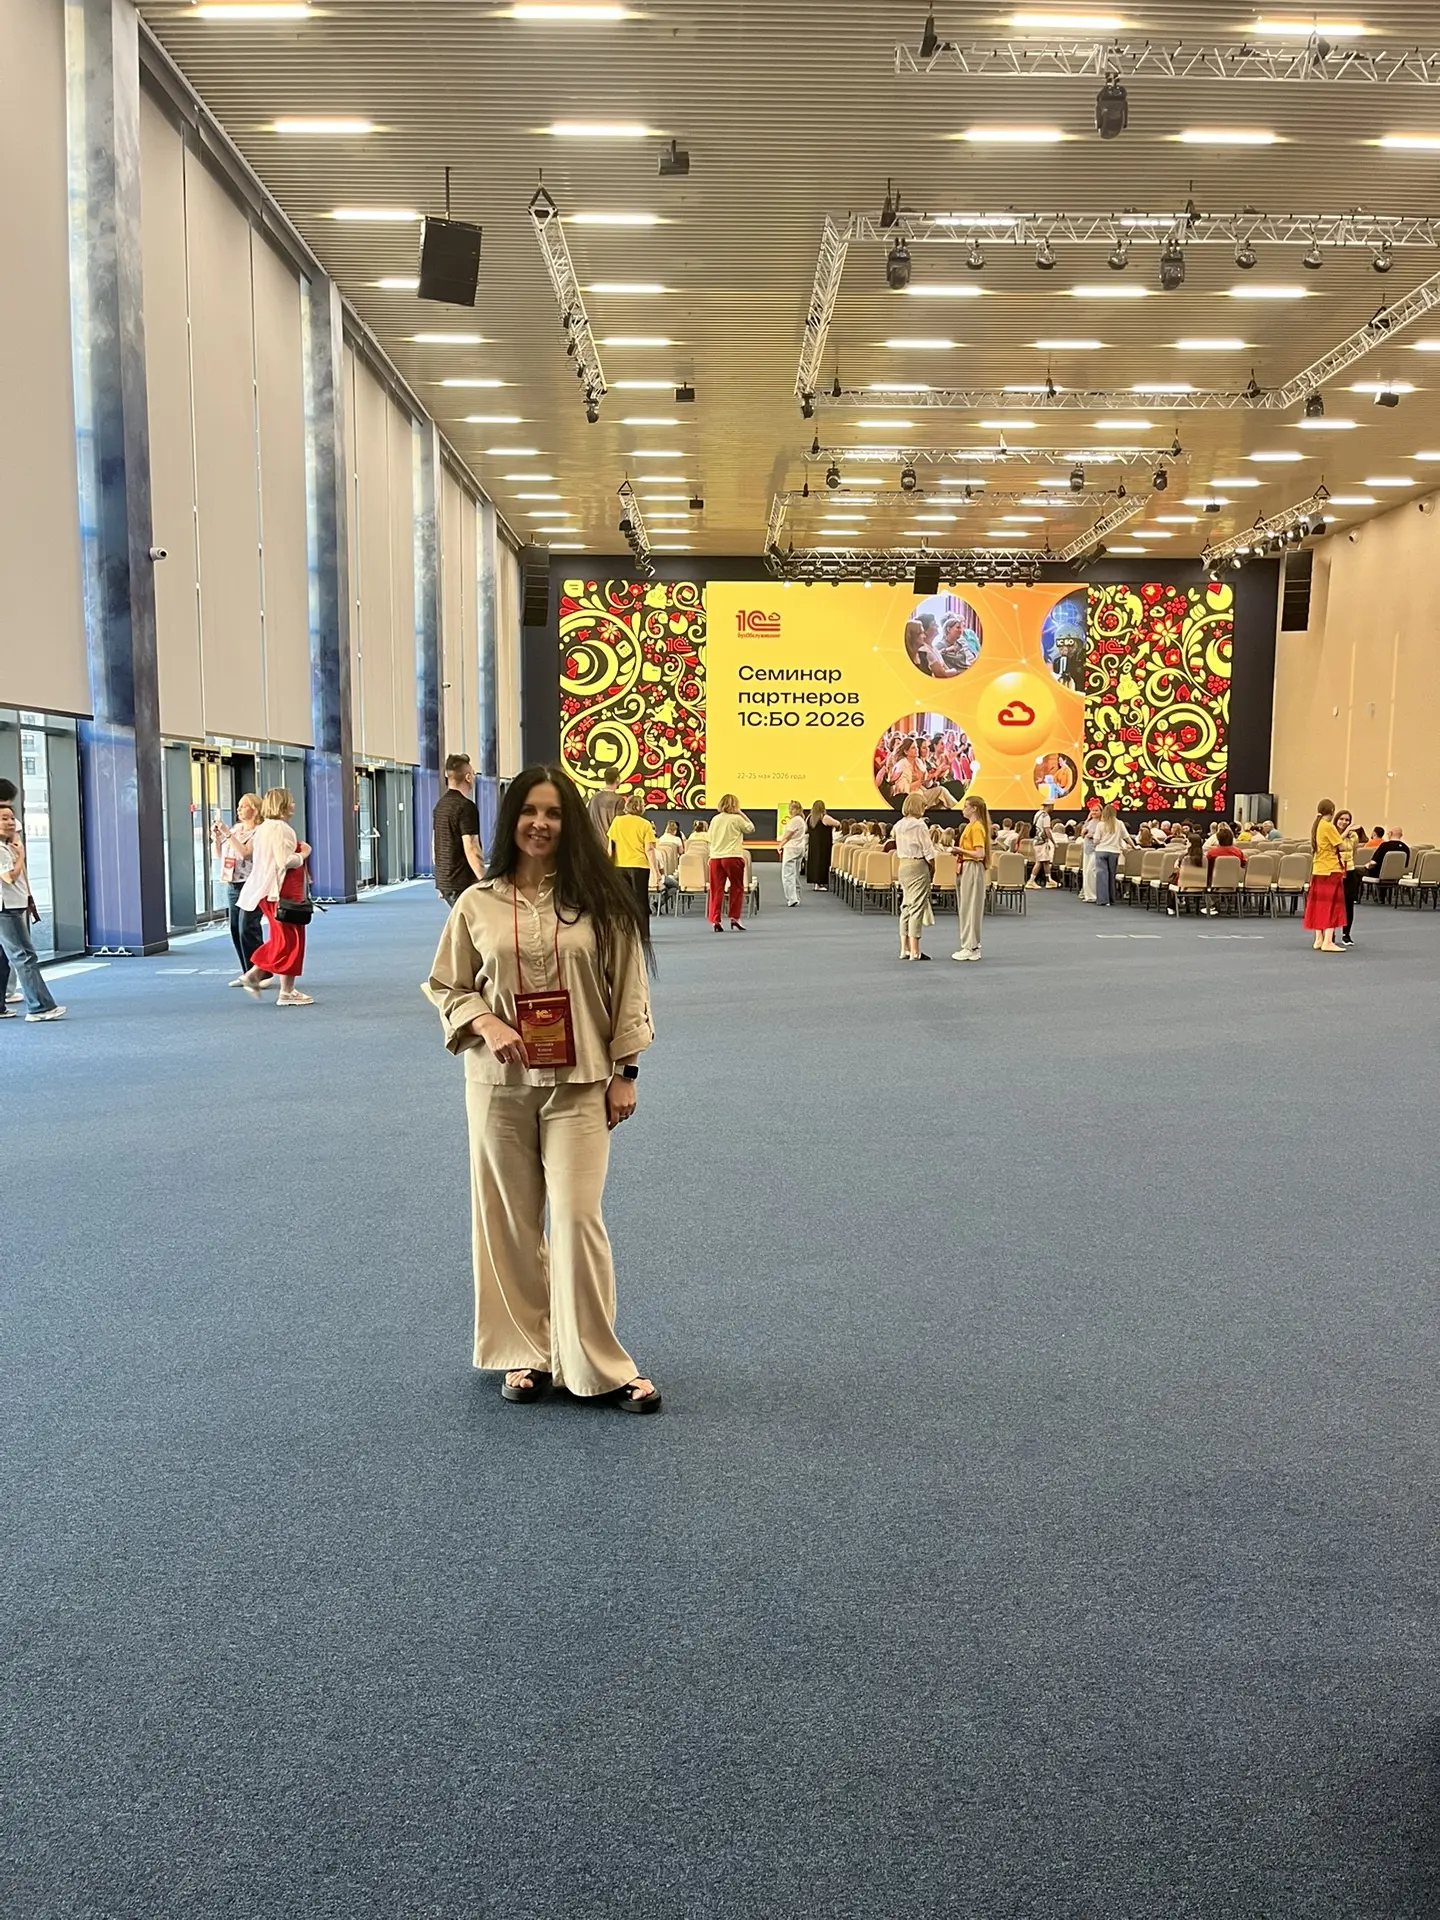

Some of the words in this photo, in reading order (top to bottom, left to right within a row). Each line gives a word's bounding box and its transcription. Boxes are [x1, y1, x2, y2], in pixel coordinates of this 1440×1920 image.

[736, 610, 780, 631] 1С
[738, 665, 842, 683] Семинар
[738, 692, 860, 707] партнеров
[737, 711, 800, 726] 1С:БО
[805, 711, 865, 727] 2026
